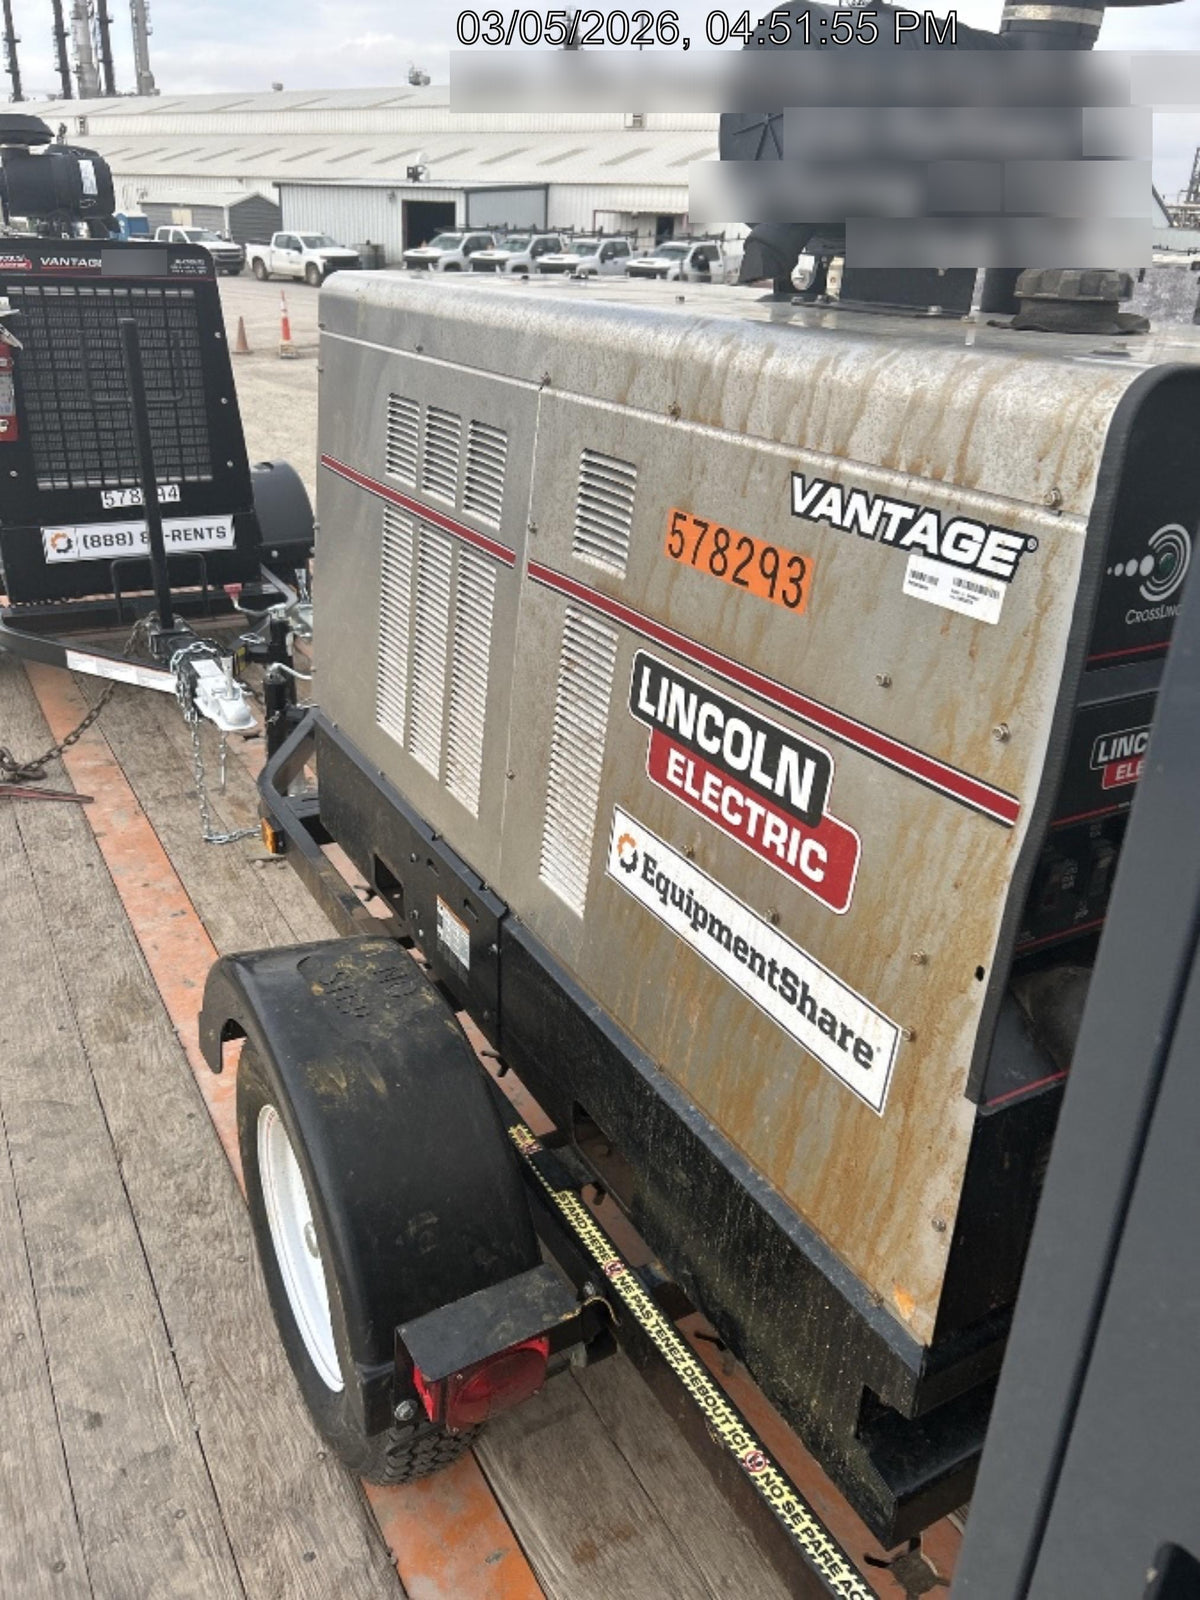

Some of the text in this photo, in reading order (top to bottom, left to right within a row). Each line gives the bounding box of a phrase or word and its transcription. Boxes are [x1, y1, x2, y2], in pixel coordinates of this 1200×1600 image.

[40, 256, 102, 268] VANTAG
[83, 526, 226, 549] (888) 8-RENTS
[104, 486, 178, 507] 57894
[668, 511, 806, 608] 578293
[637, 665, 817, 812] LINCOLN
[1097, 732, 1149, 763] LINC
[665, 747, 828, 883] ELECTRIC
[641, 851, 874, 1071] EquipmentShare
[559, 1191, 613, 1262] STAND HERE
[616, 1275, 750, 1451] NE PAS TENEZ DEBOUT ICI
[760, 1472, 785, 1499] NO
[781, 1500, 805, 1526] SE
[800, 1526, 844, 1578] PARE
